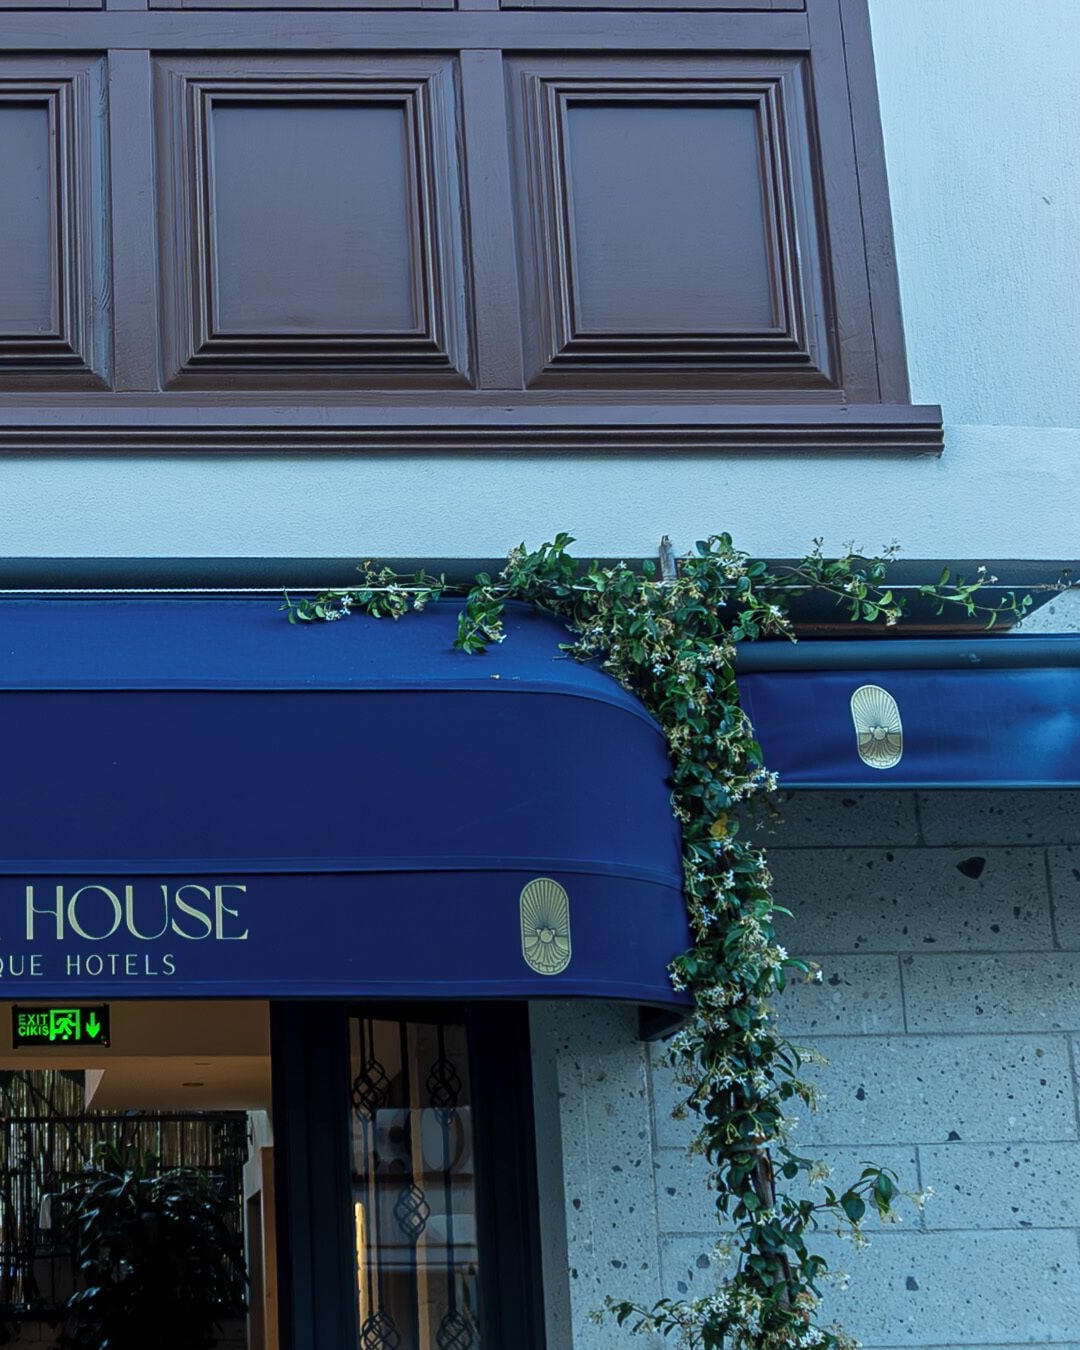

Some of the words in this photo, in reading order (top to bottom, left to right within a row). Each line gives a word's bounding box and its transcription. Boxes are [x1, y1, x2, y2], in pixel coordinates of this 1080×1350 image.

[26, 884, 249, 940] HOUSE
[66, 953, 177, 976] HOTELS
[18, 1013, 49, 1026] EXIT
